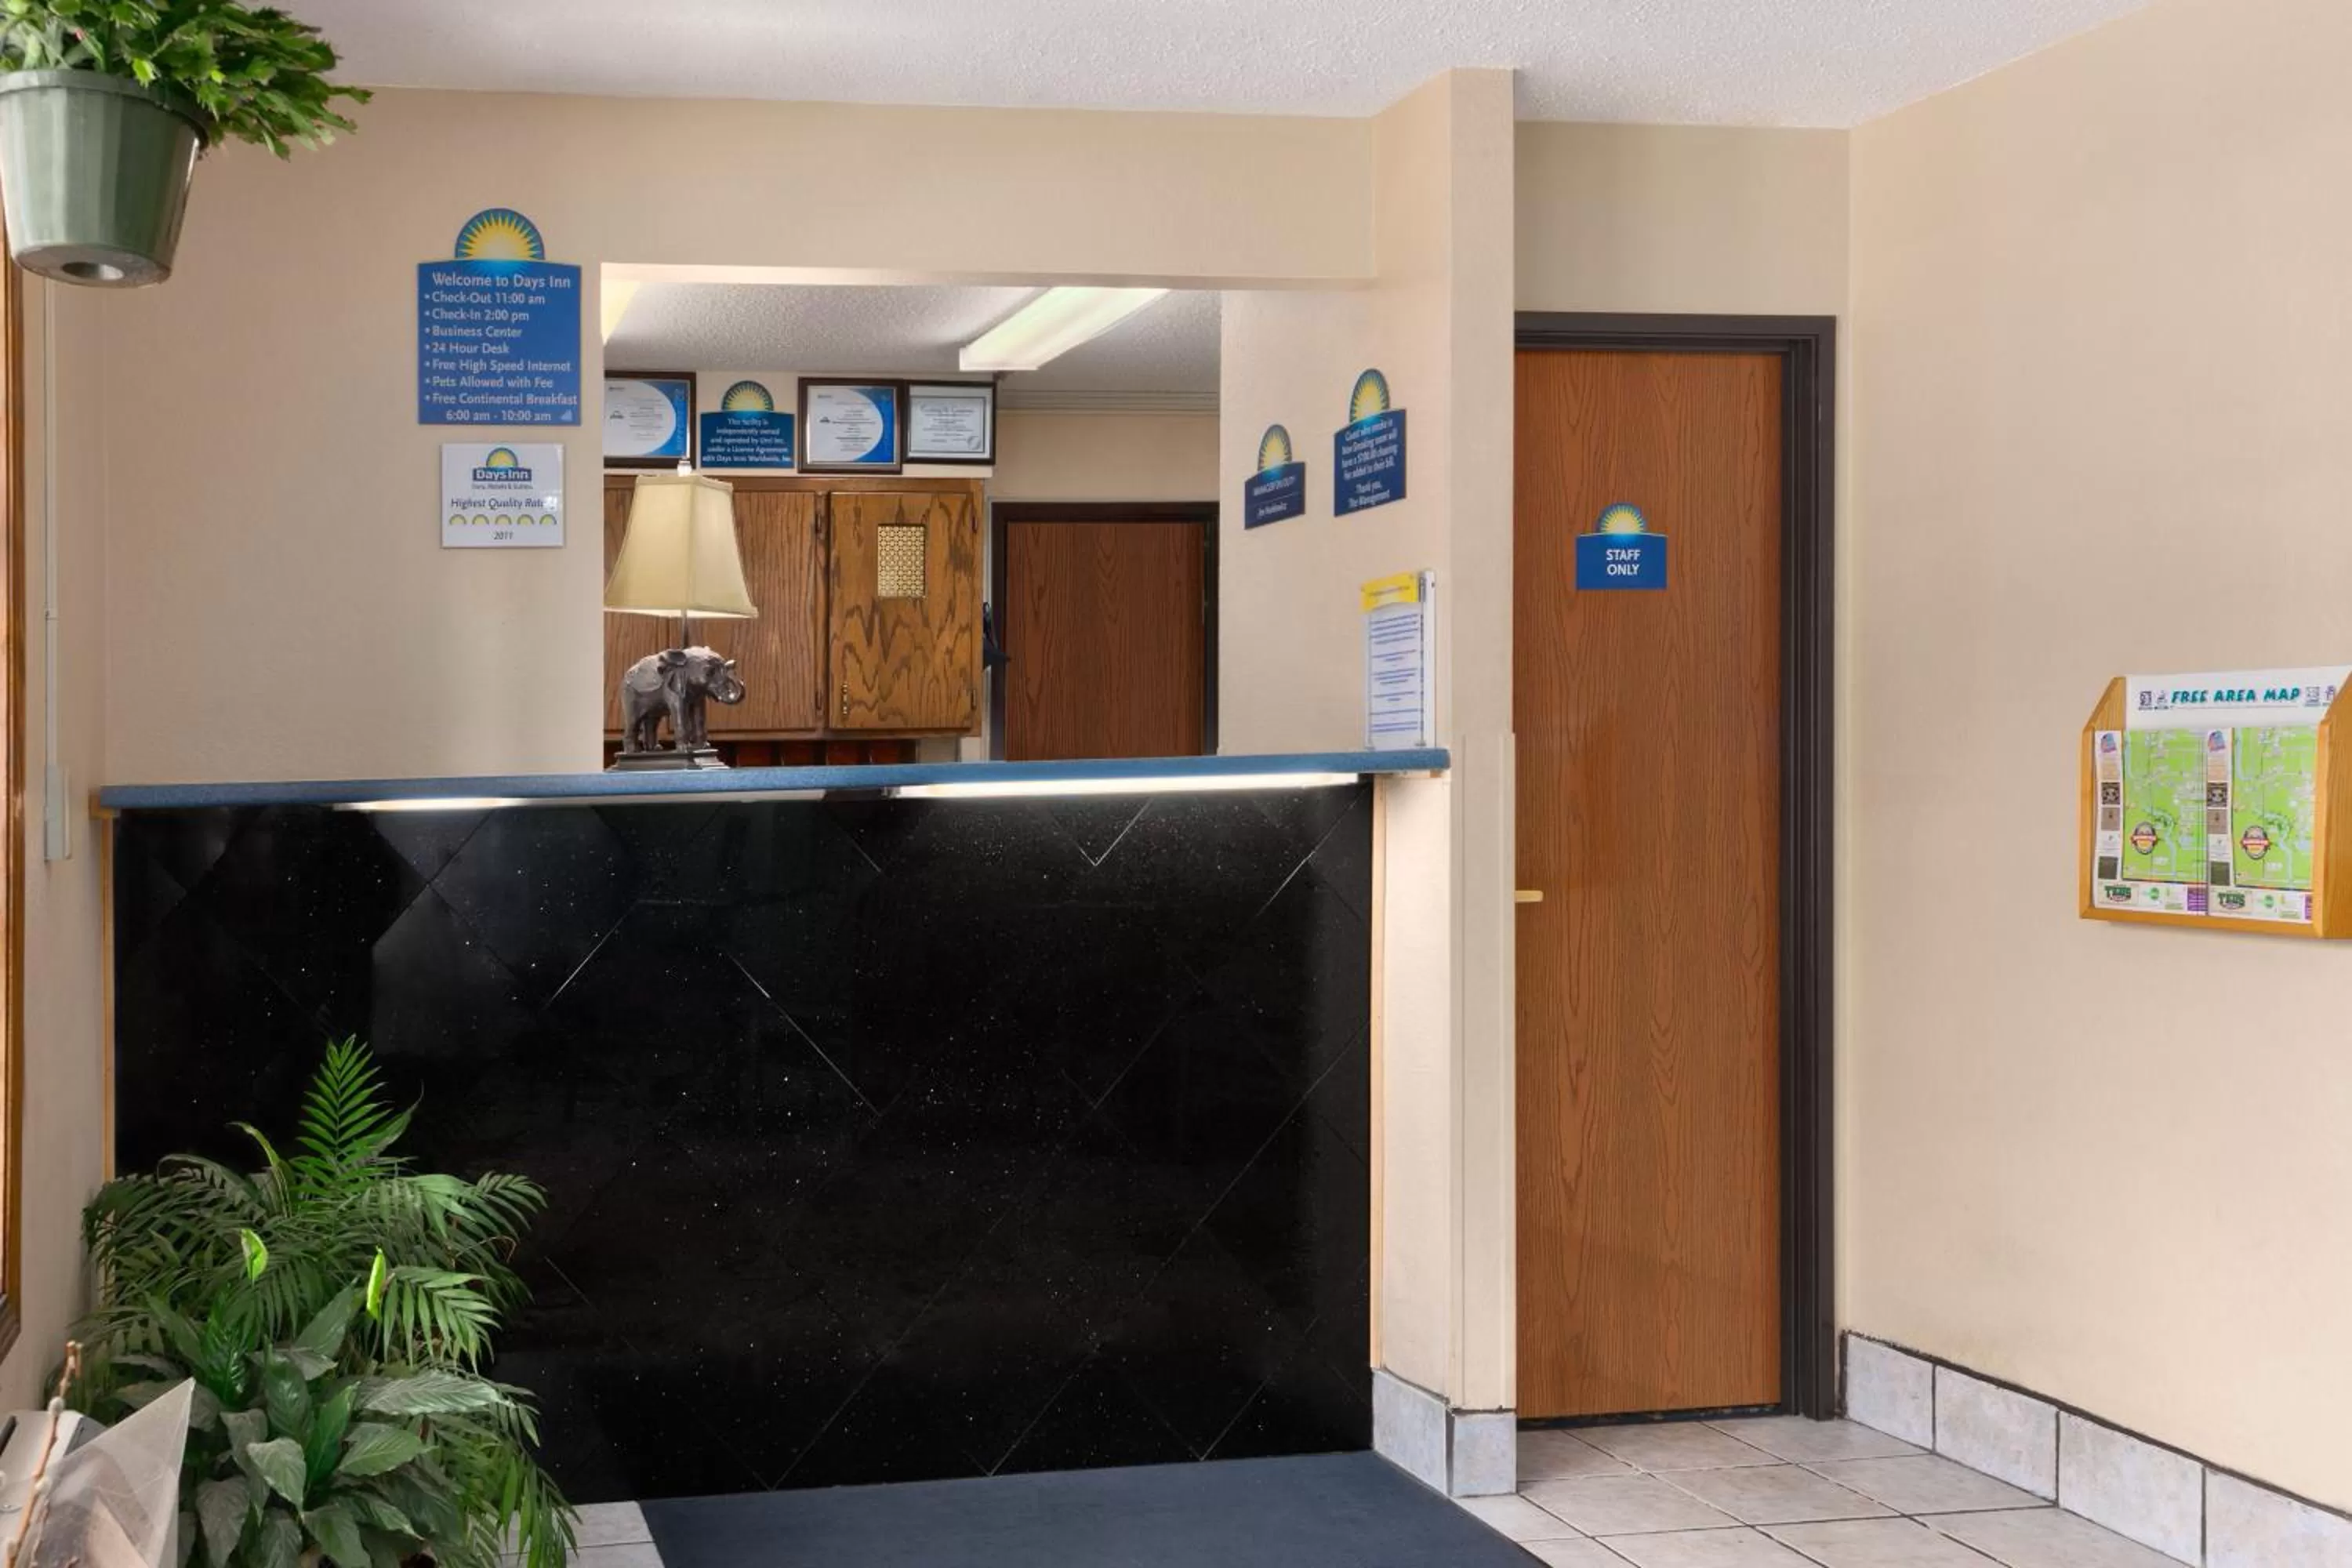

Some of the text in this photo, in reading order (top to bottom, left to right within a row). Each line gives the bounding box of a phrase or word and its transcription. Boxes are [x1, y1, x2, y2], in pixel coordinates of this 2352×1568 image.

[432, 272, 571, 289] Welcome to Days Inn
[432, 291, 546, 305] Check-Out 11:00 am
[432, 308, 529, 324] Check-In 2:00 pm
[432, 325, 523, 338] Business Center
[432, 341, 510, 354] 24 Hour Desk
[432, 358, 571, 373] Free High Speed Internet
[432, 376, 554, 389] Pets Allowed with Fee
[432, 393, 578, 406] Free Continental Breakfast
[445, 409, 470, 421] 6:00
[473, 411, 491, 421] am
[501, 409, 532, 422] 10:00
[534, 412, 552, 422] am
[476, 469, 528, 481] Days Inn
[451, 498, 486, 510] Highest
[488, 498, 523, 510] Quality
[1606, 549, 1641, 561] STAFF
[1606, 564, 1640, 576] ONLY
[2170, 687, 2301, 704] FREE AREA MAP
